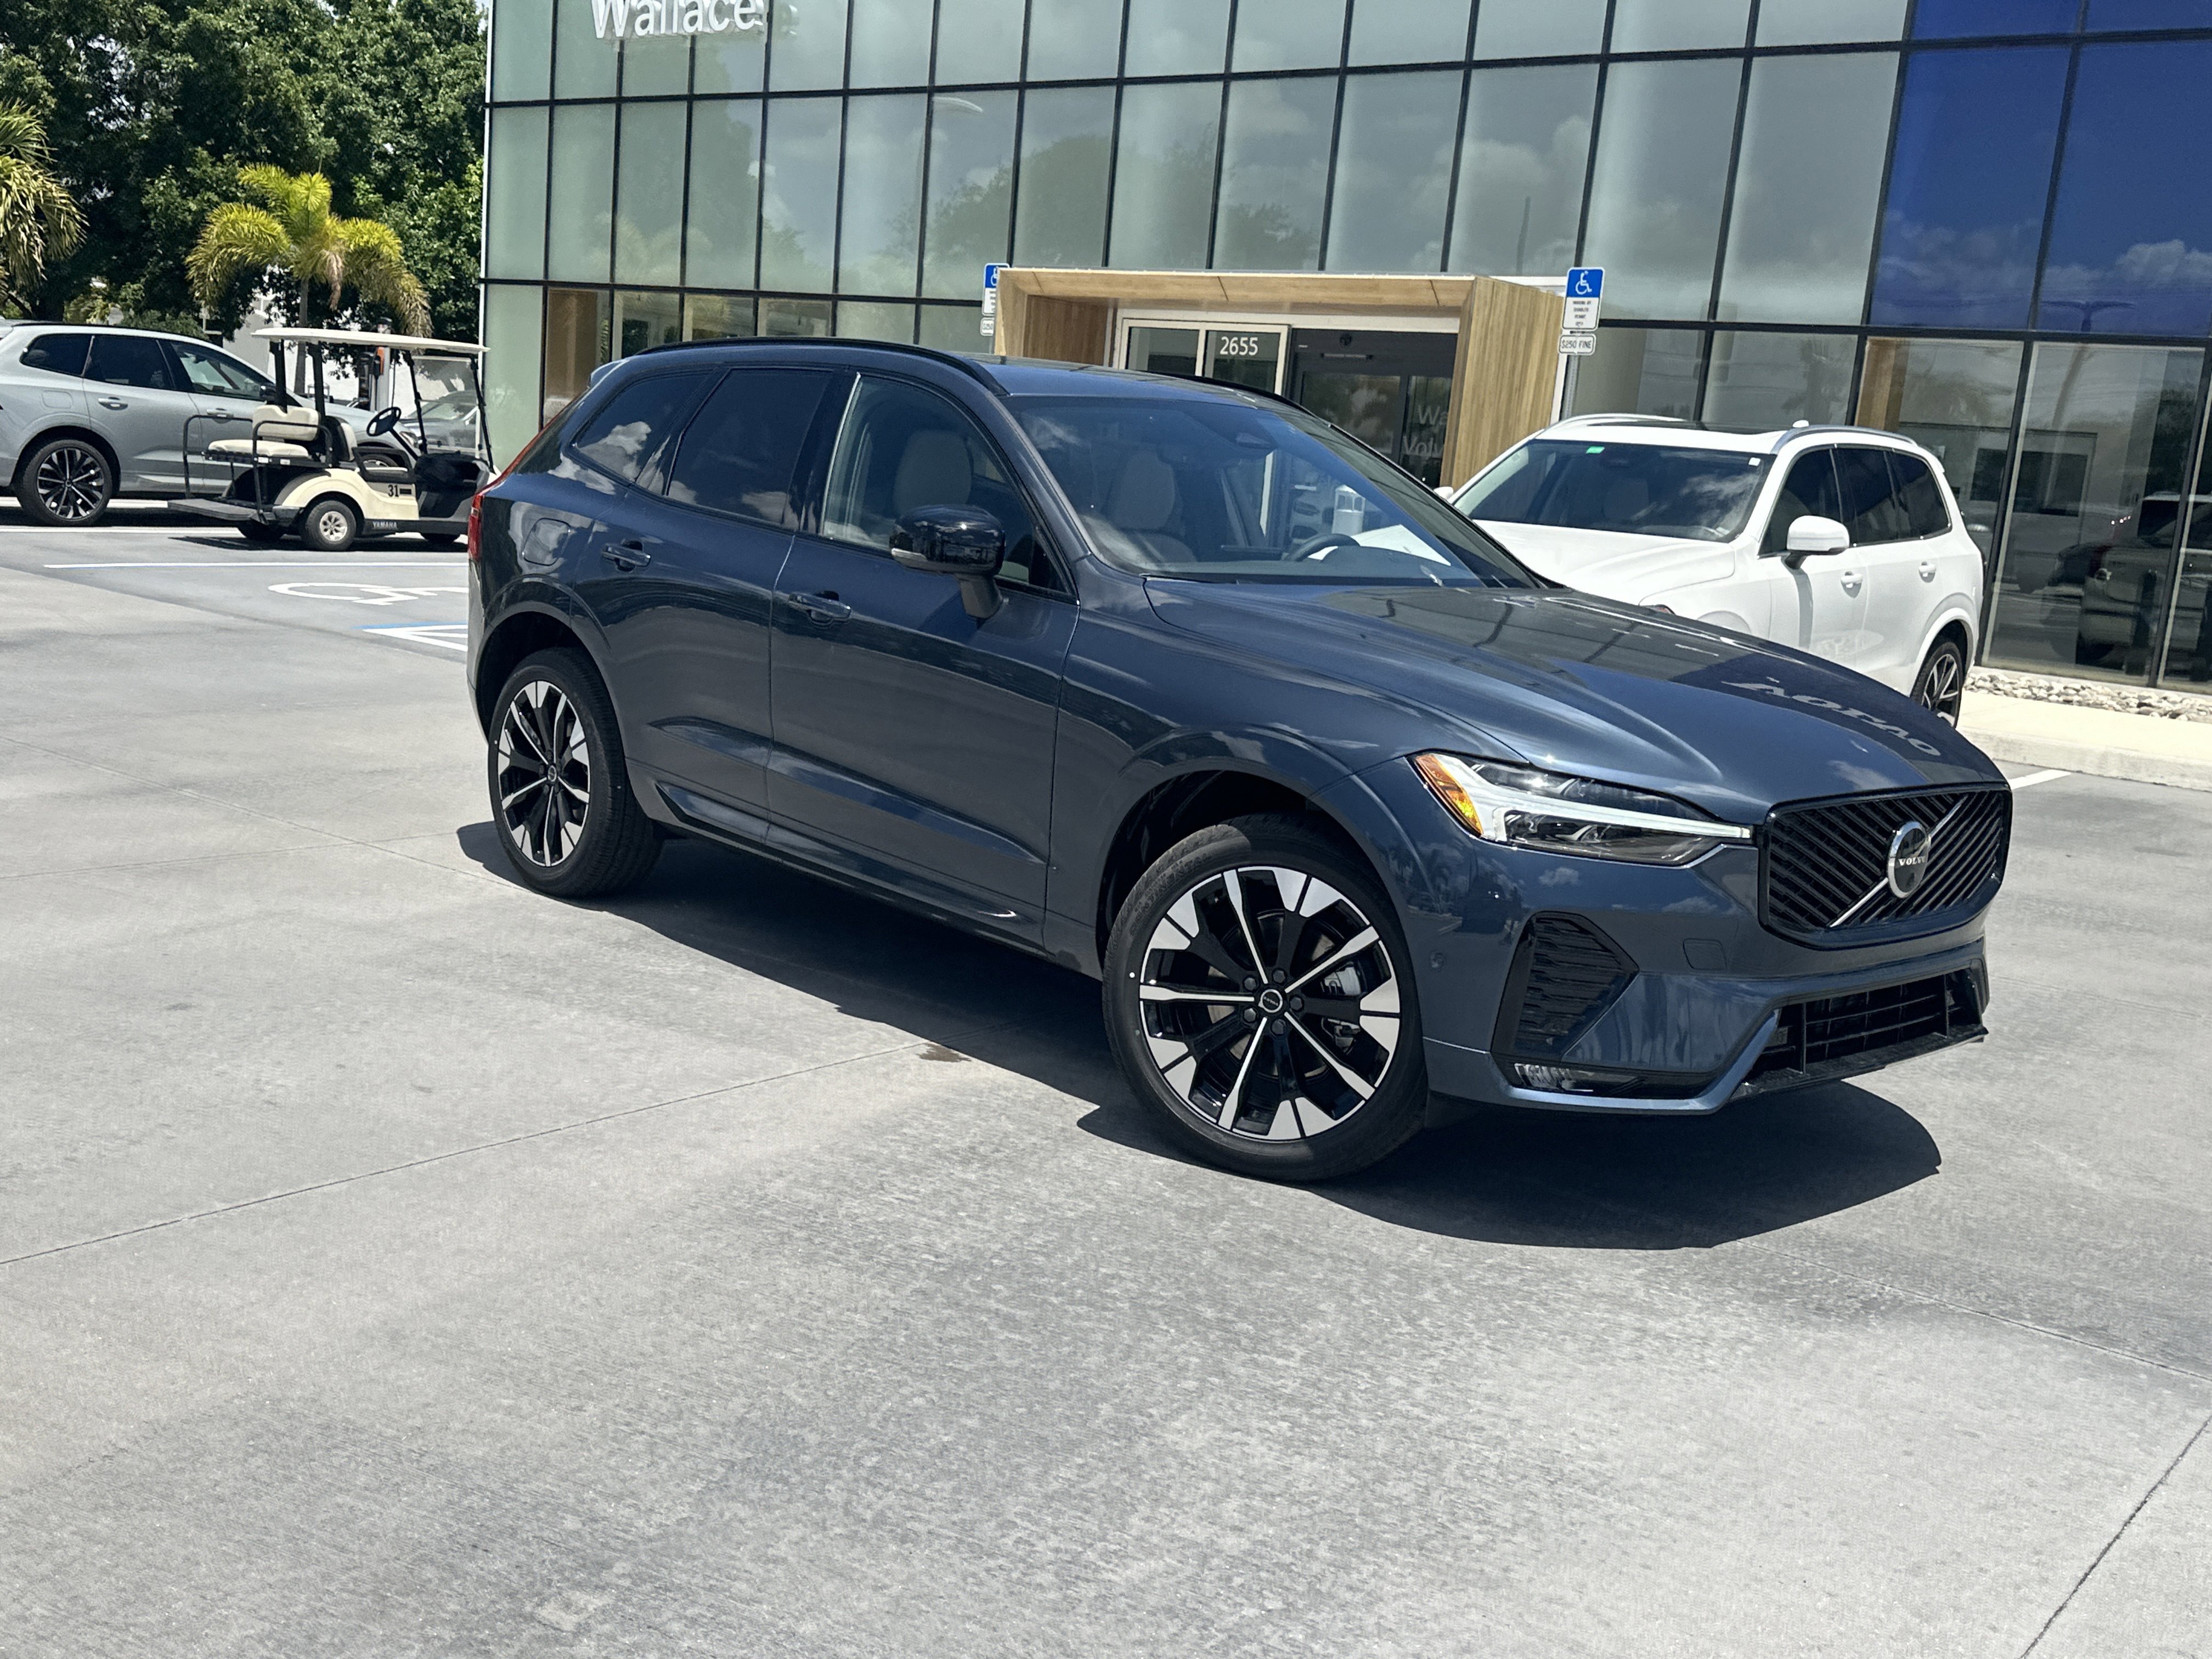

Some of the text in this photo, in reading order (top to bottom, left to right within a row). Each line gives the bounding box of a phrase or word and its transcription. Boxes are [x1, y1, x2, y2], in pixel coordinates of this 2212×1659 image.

[591, 0, 763, 39] Wallace
[1220, 336, 1259, 356] 2655
[1562, 339, 1592, 349] $250 FINE
[387, 484, 399, 498] 31
[373, 521, 398, 530] YAMAHA
[1898, 856, 1926, 866] VOLVO
